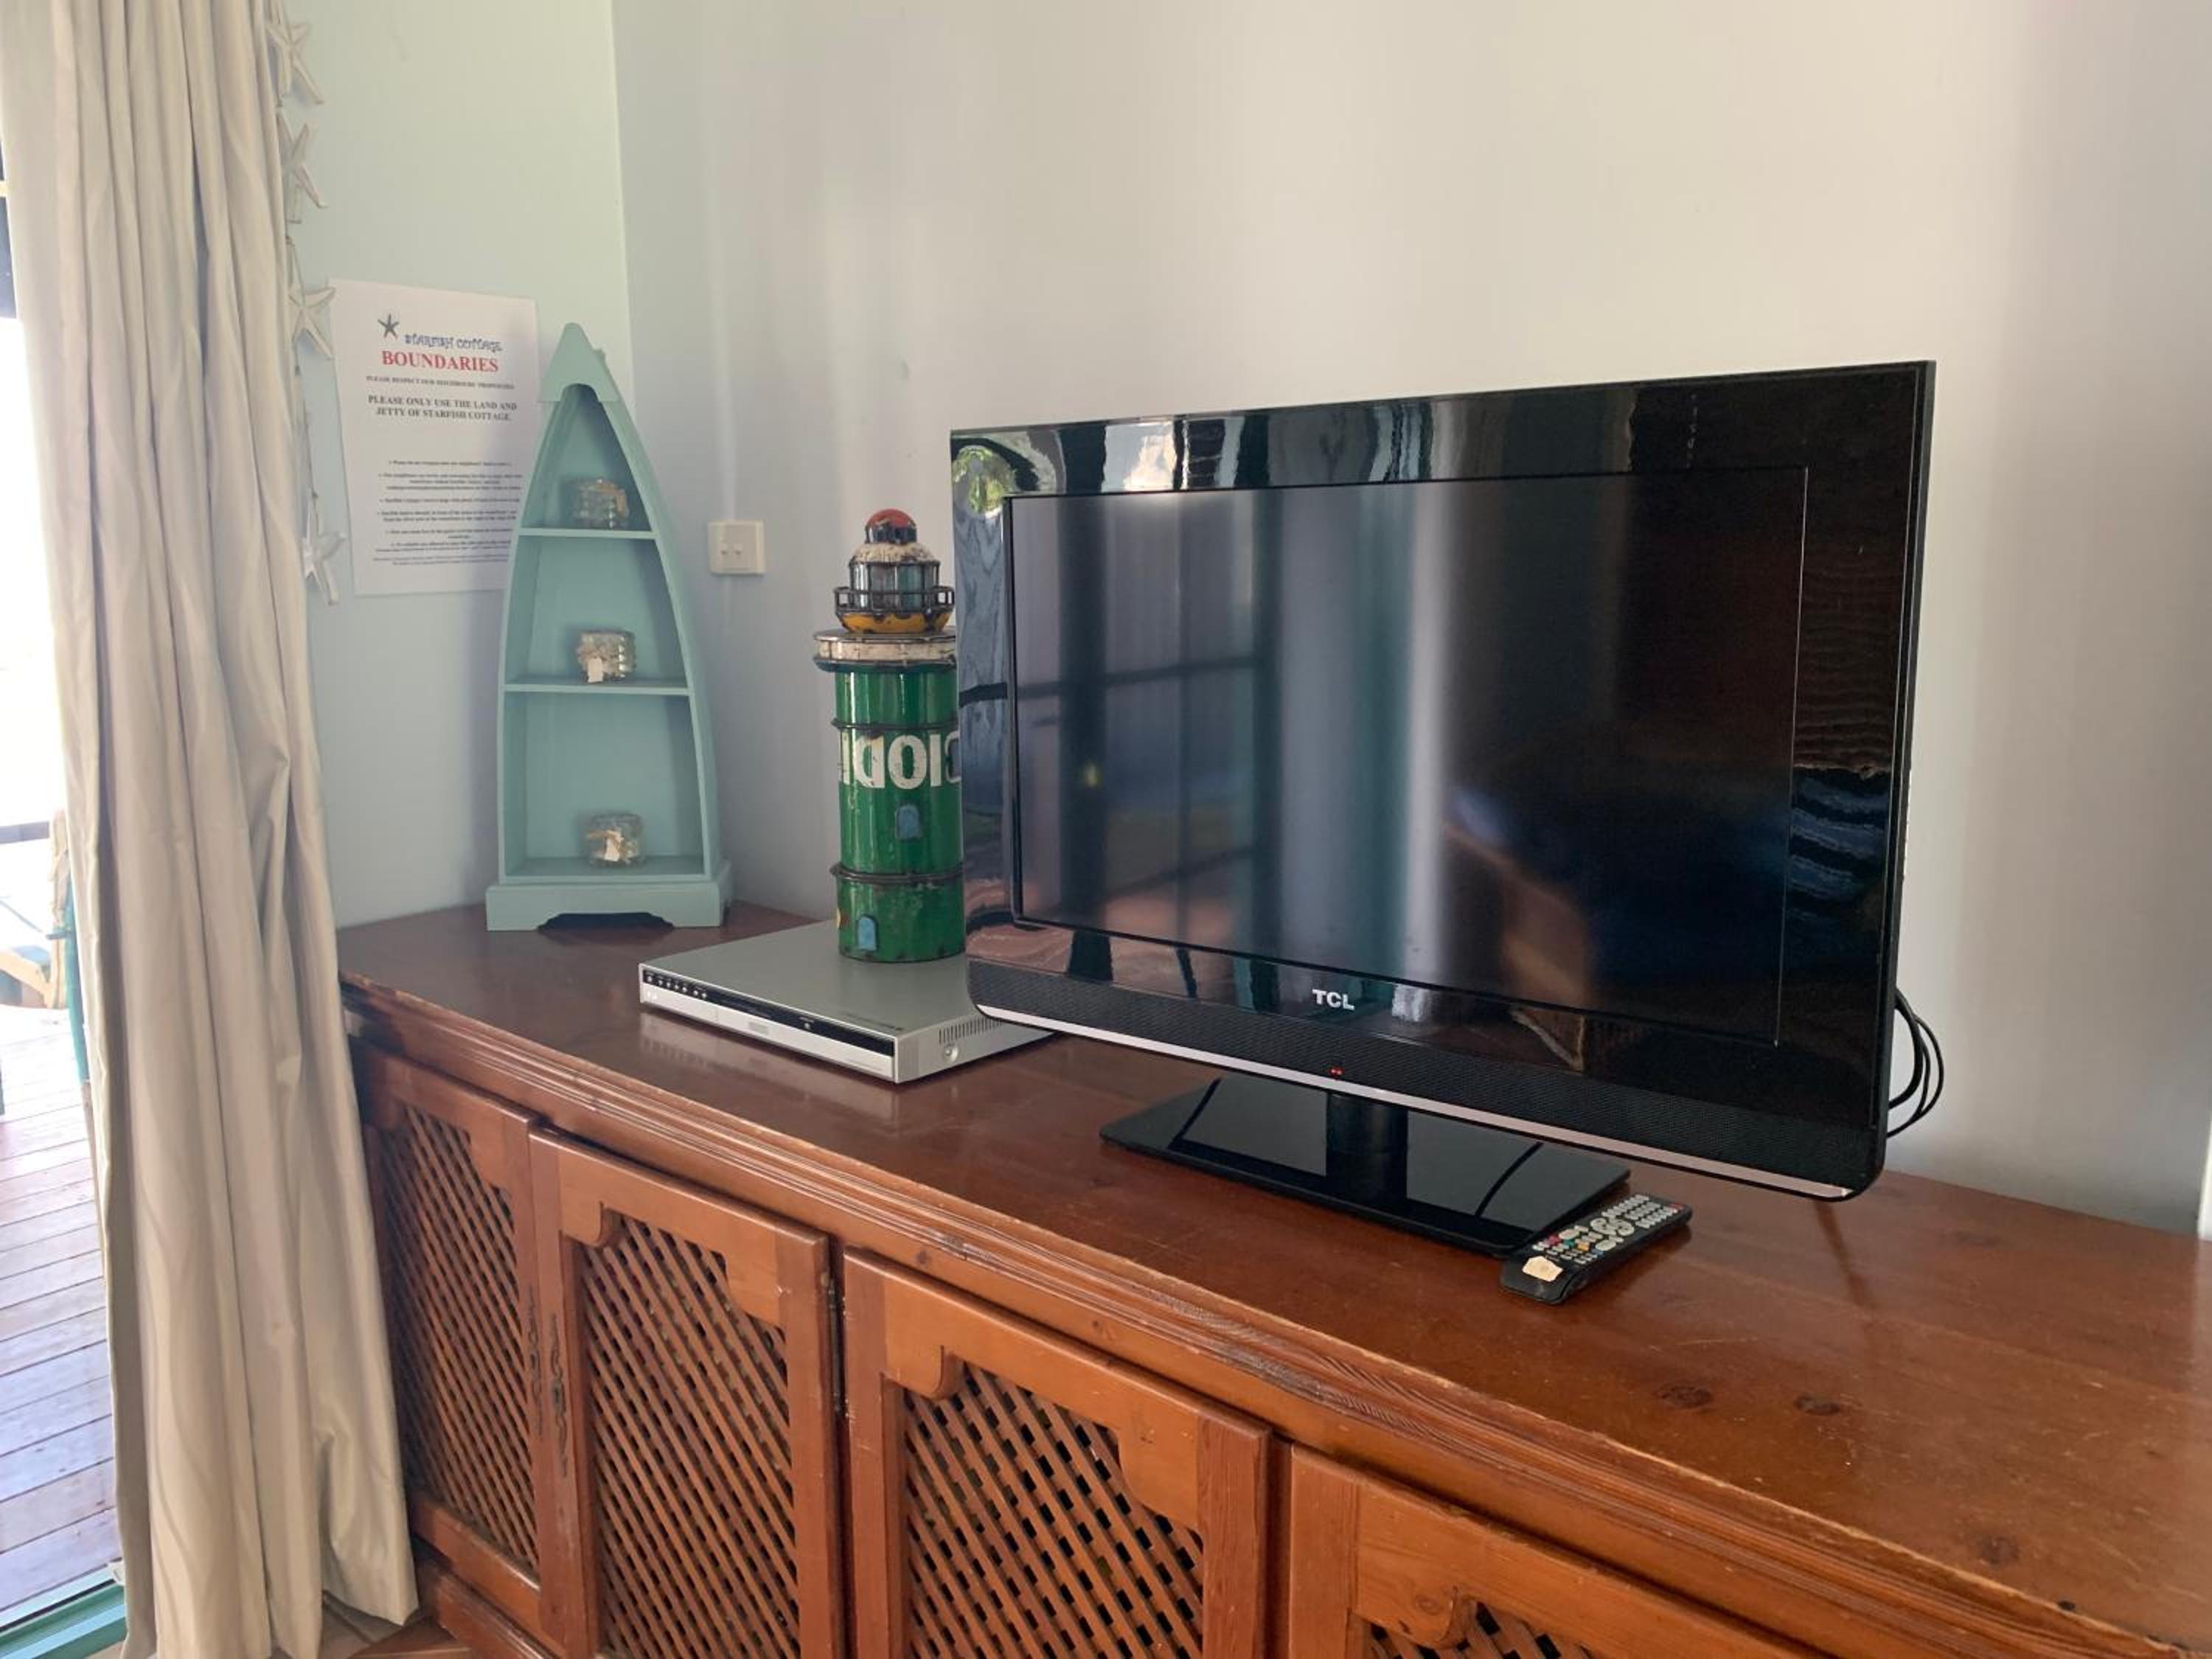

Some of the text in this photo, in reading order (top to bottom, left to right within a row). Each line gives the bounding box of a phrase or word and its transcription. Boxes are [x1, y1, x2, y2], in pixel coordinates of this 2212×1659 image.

[381, 350, 498, 372] BOUNDARIES
[368, 395, 517, 411] PLEASE ONLY USE THE LAND AND
[377, 406, 405, 416] JETTY
[408, 408, 420, 417] OF
[423, 409, 466, 419] STARFISH
[1312, 989, 1355, 1011] TCL
